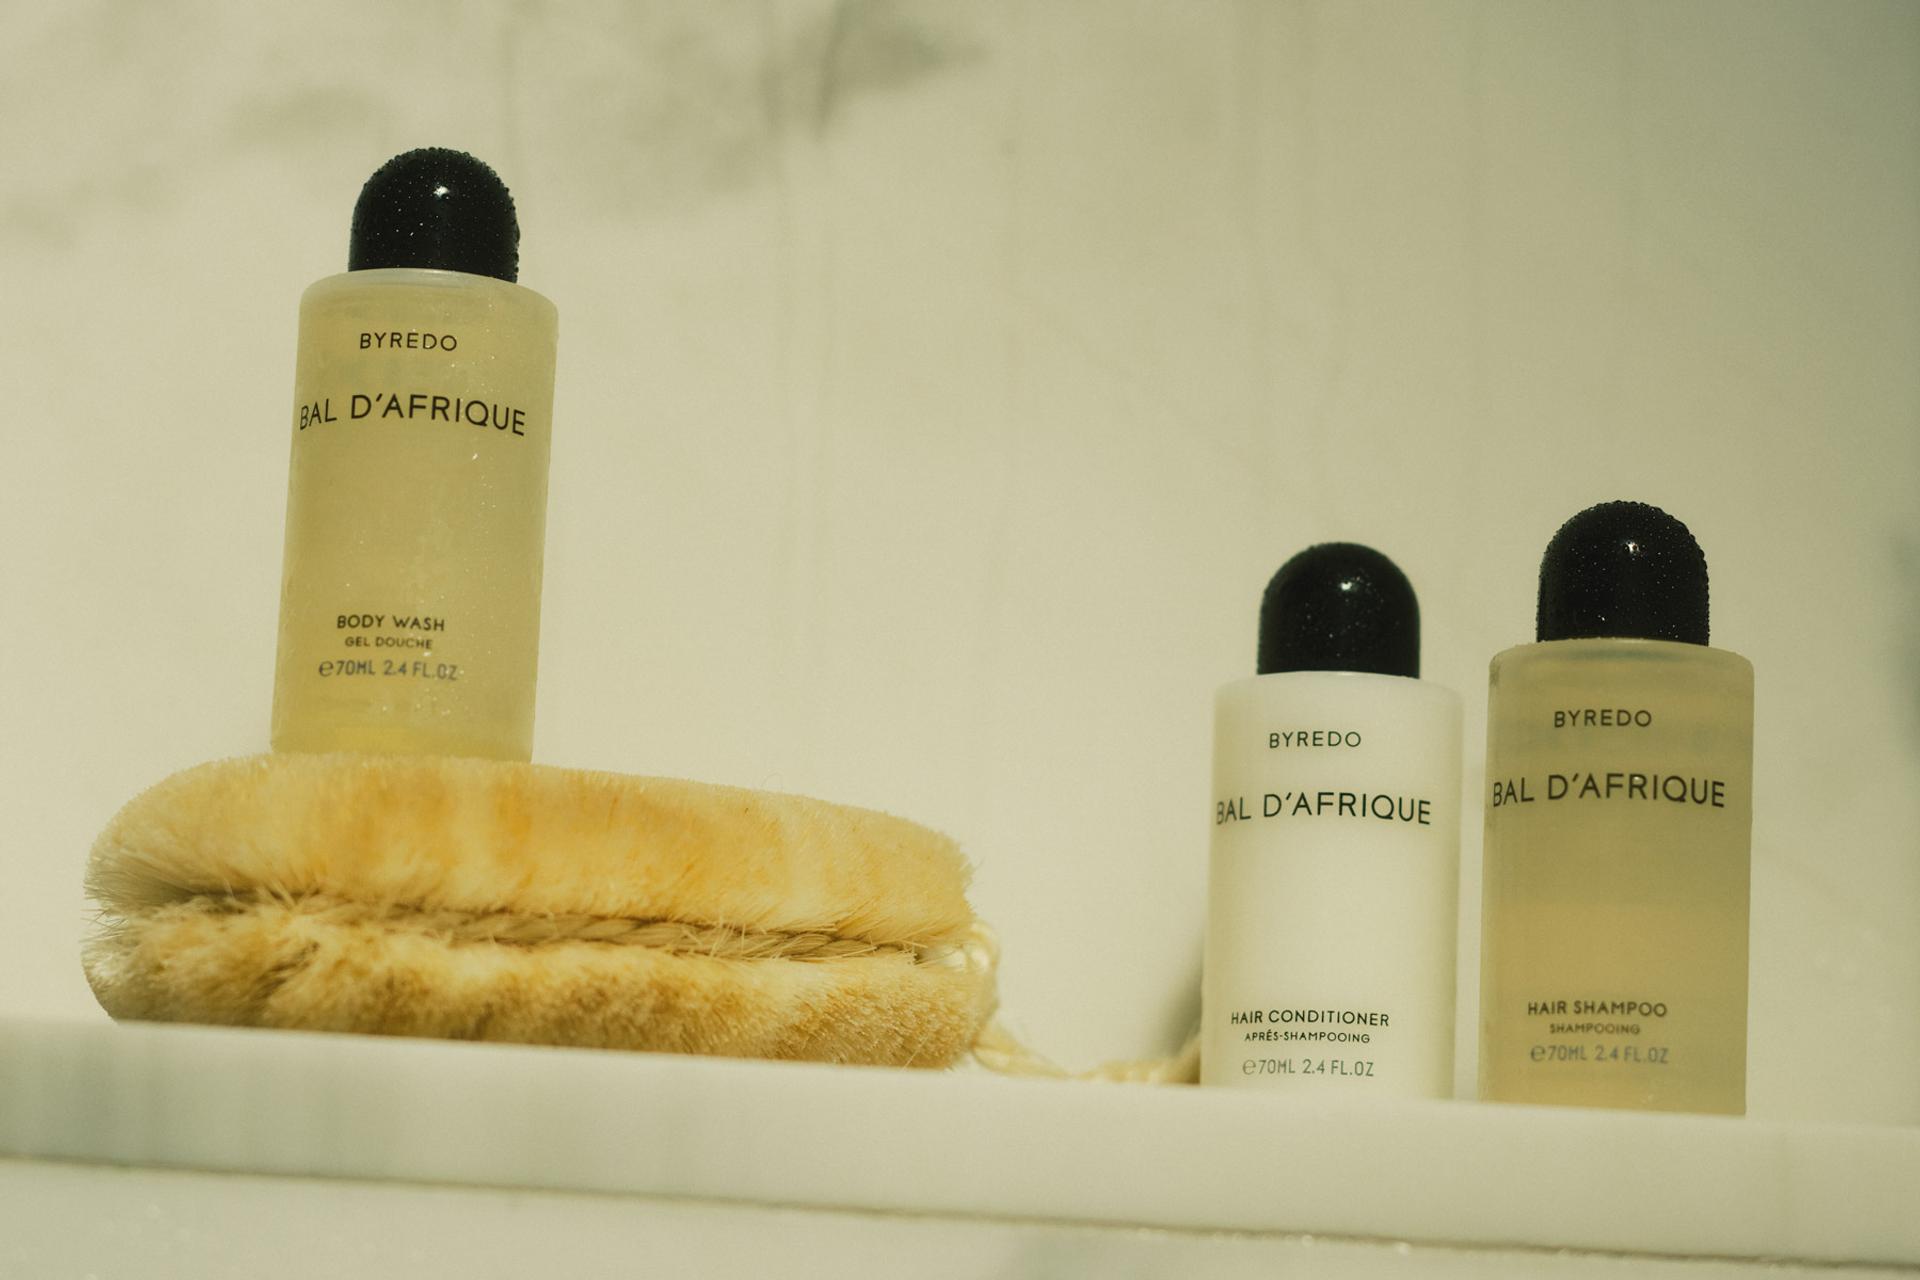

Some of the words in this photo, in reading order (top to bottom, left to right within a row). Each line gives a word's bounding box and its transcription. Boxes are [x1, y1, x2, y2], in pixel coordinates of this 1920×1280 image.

[359, 332, 457, 351] BYREDO
[300, 398, 337, 430] BAL
[350, 393, 525, 436] D'AFRIQUE
[336, 614, 385, 629] BODY
[392, 615, 445, 631] WASH
[344, 636, 370, 647] GEL
[375, 636, 433, 650] DOUCHE
[383, 659, 407, 676] 2.4
[1554, 709, 1652, 728] BYREDO
[1269, 731, 1361, 748] BYREDO
[1493, 777, 1535, 808] BAL
[1547, 773, 1725, 808] D'AFRIQUE
[1216, 797, 1252, 825] BAL
[1263, 792, 1431, 825] D'AFRIQUE
[1231, 1010, 1263, 1025] HAIR
[1268, 1009, 1389, 1027] CONDITIONER
[1527, 1001, 1567, 1016] HAIR
[1573, 1001, 1668, 1018] SHAMPOO
[1549, 1023, 1640, 1035] SHAMPOOING
[1595, 1045, 1619, 1062] 2.4
[1302, 1058, 1325, 1075] 2.4
